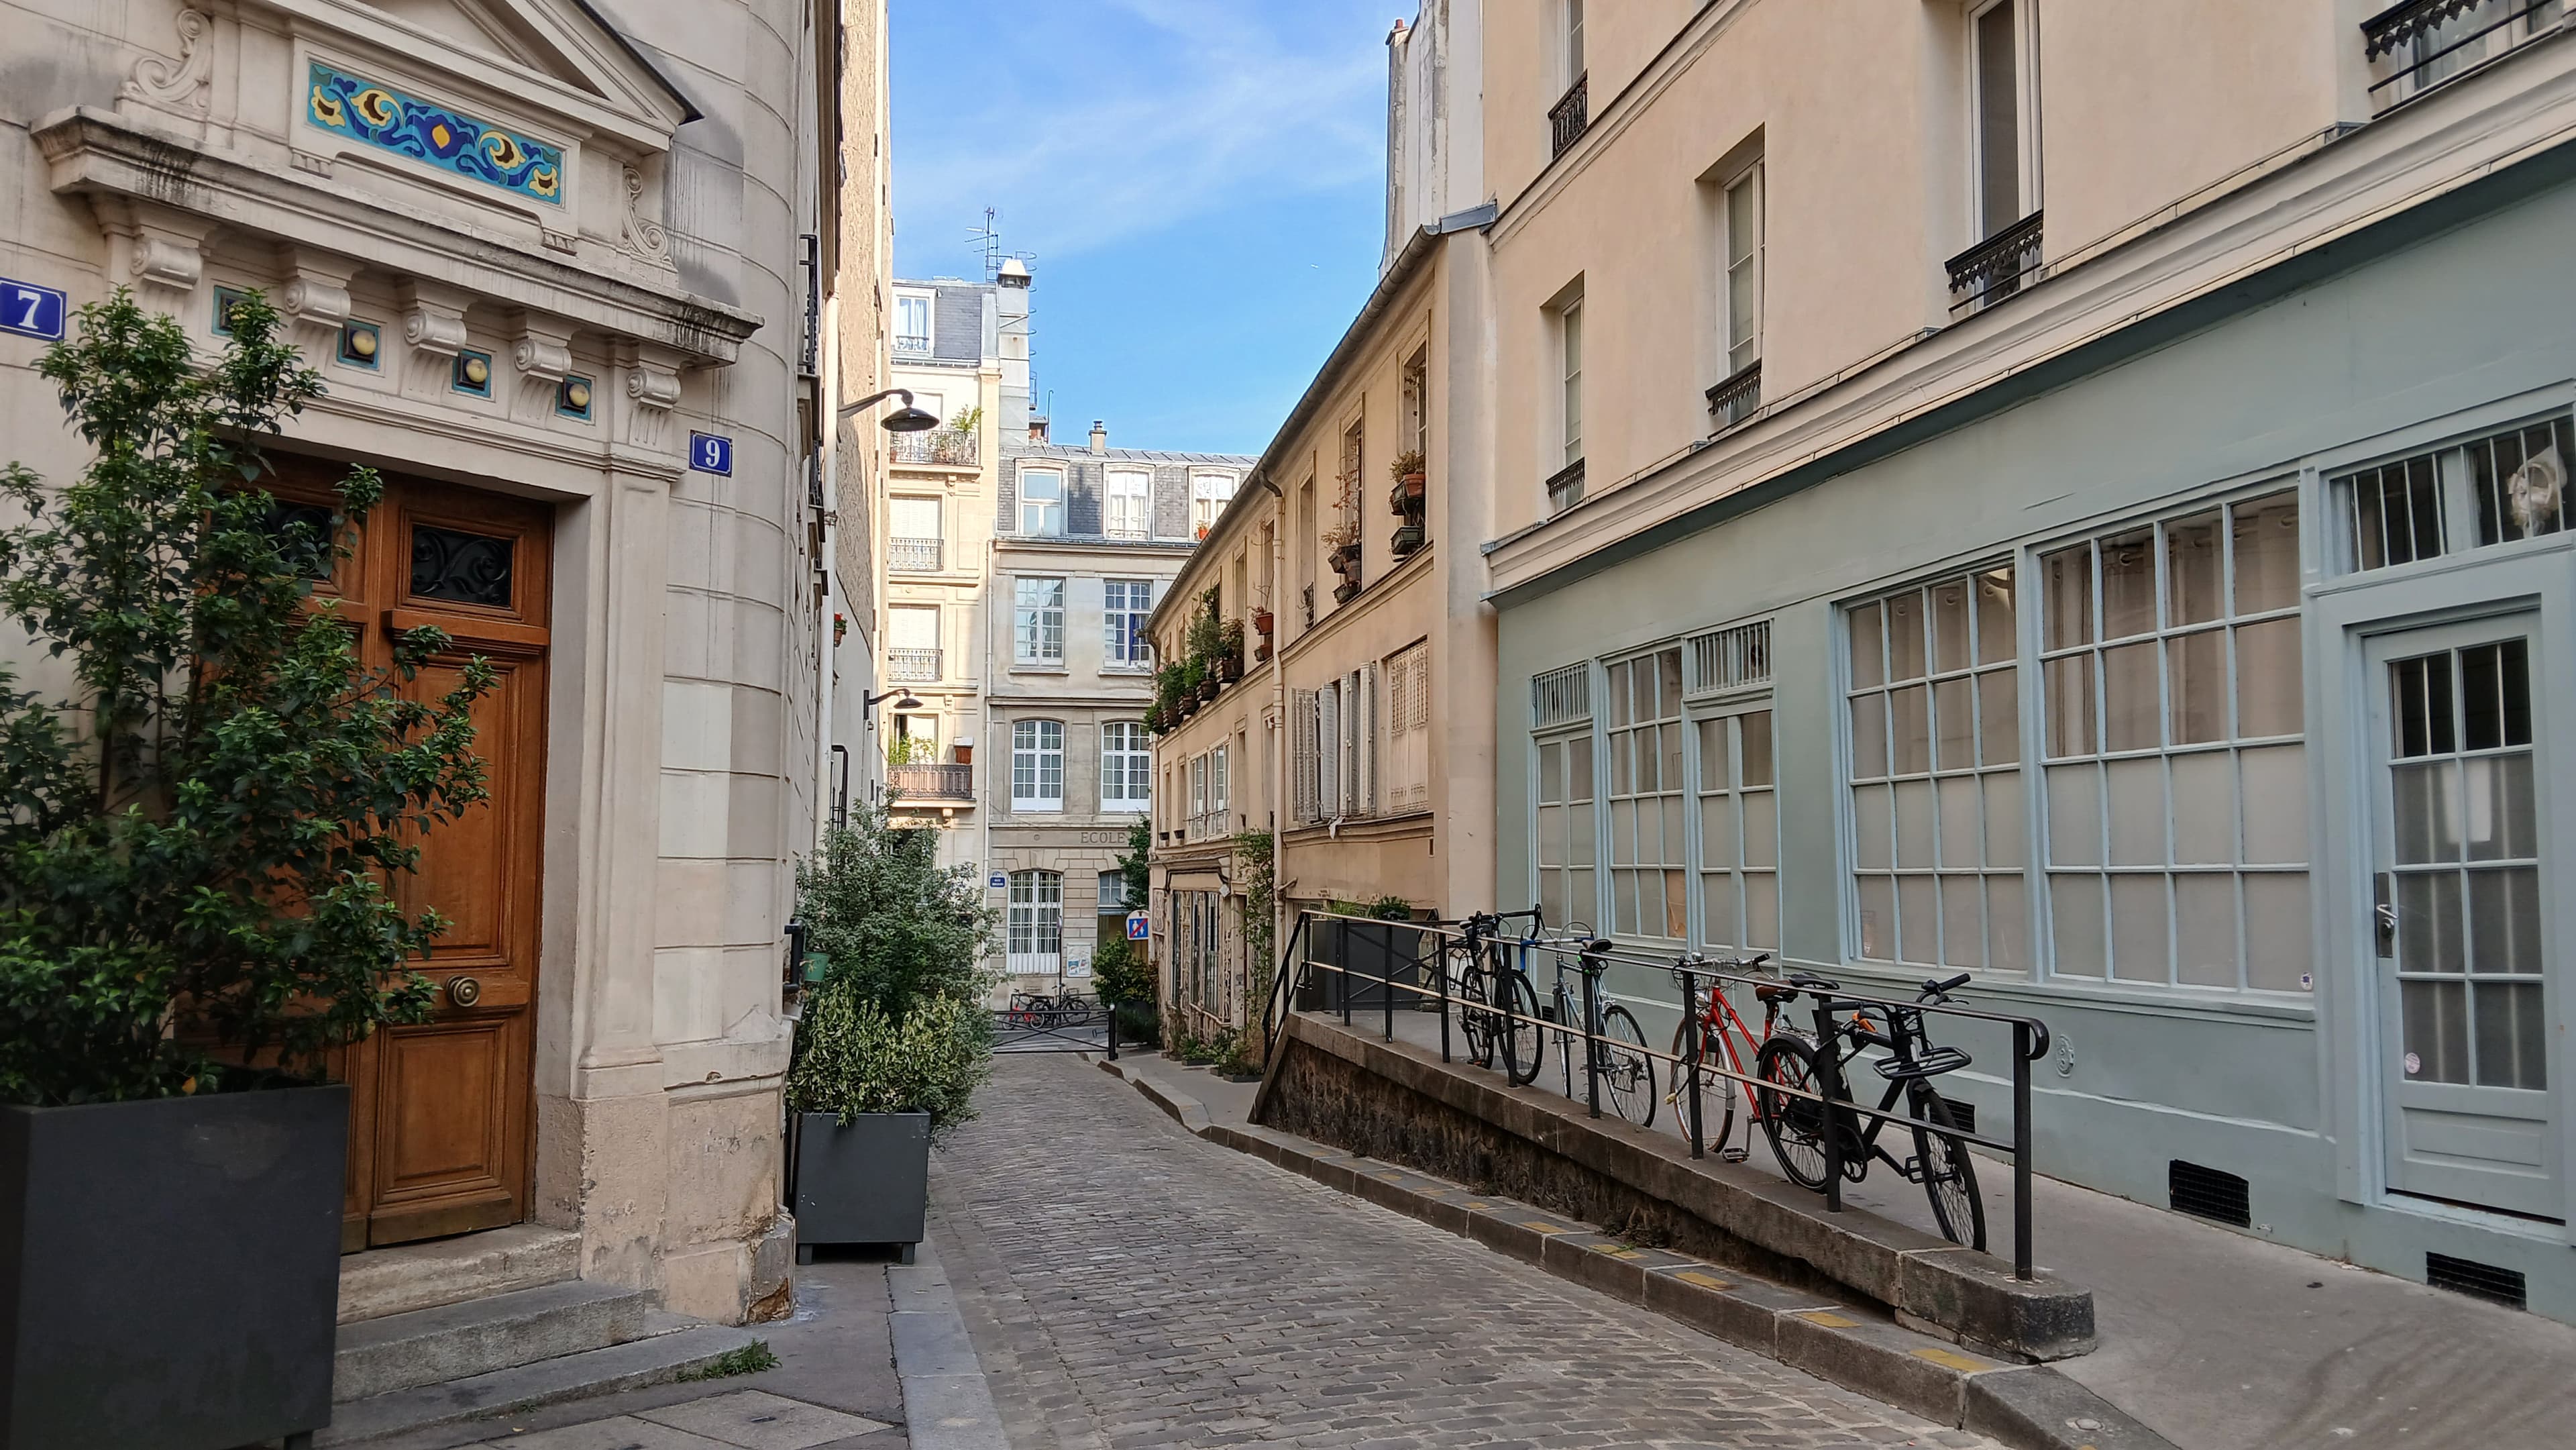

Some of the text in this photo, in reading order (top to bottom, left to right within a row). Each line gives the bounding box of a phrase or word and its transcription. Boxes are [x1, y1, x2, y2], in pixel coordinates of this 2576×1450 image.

[17, 289, 42, 329] 7
[705, 439, 720, 468] 9
[1081, 832, 1125, 843] ECOLE
